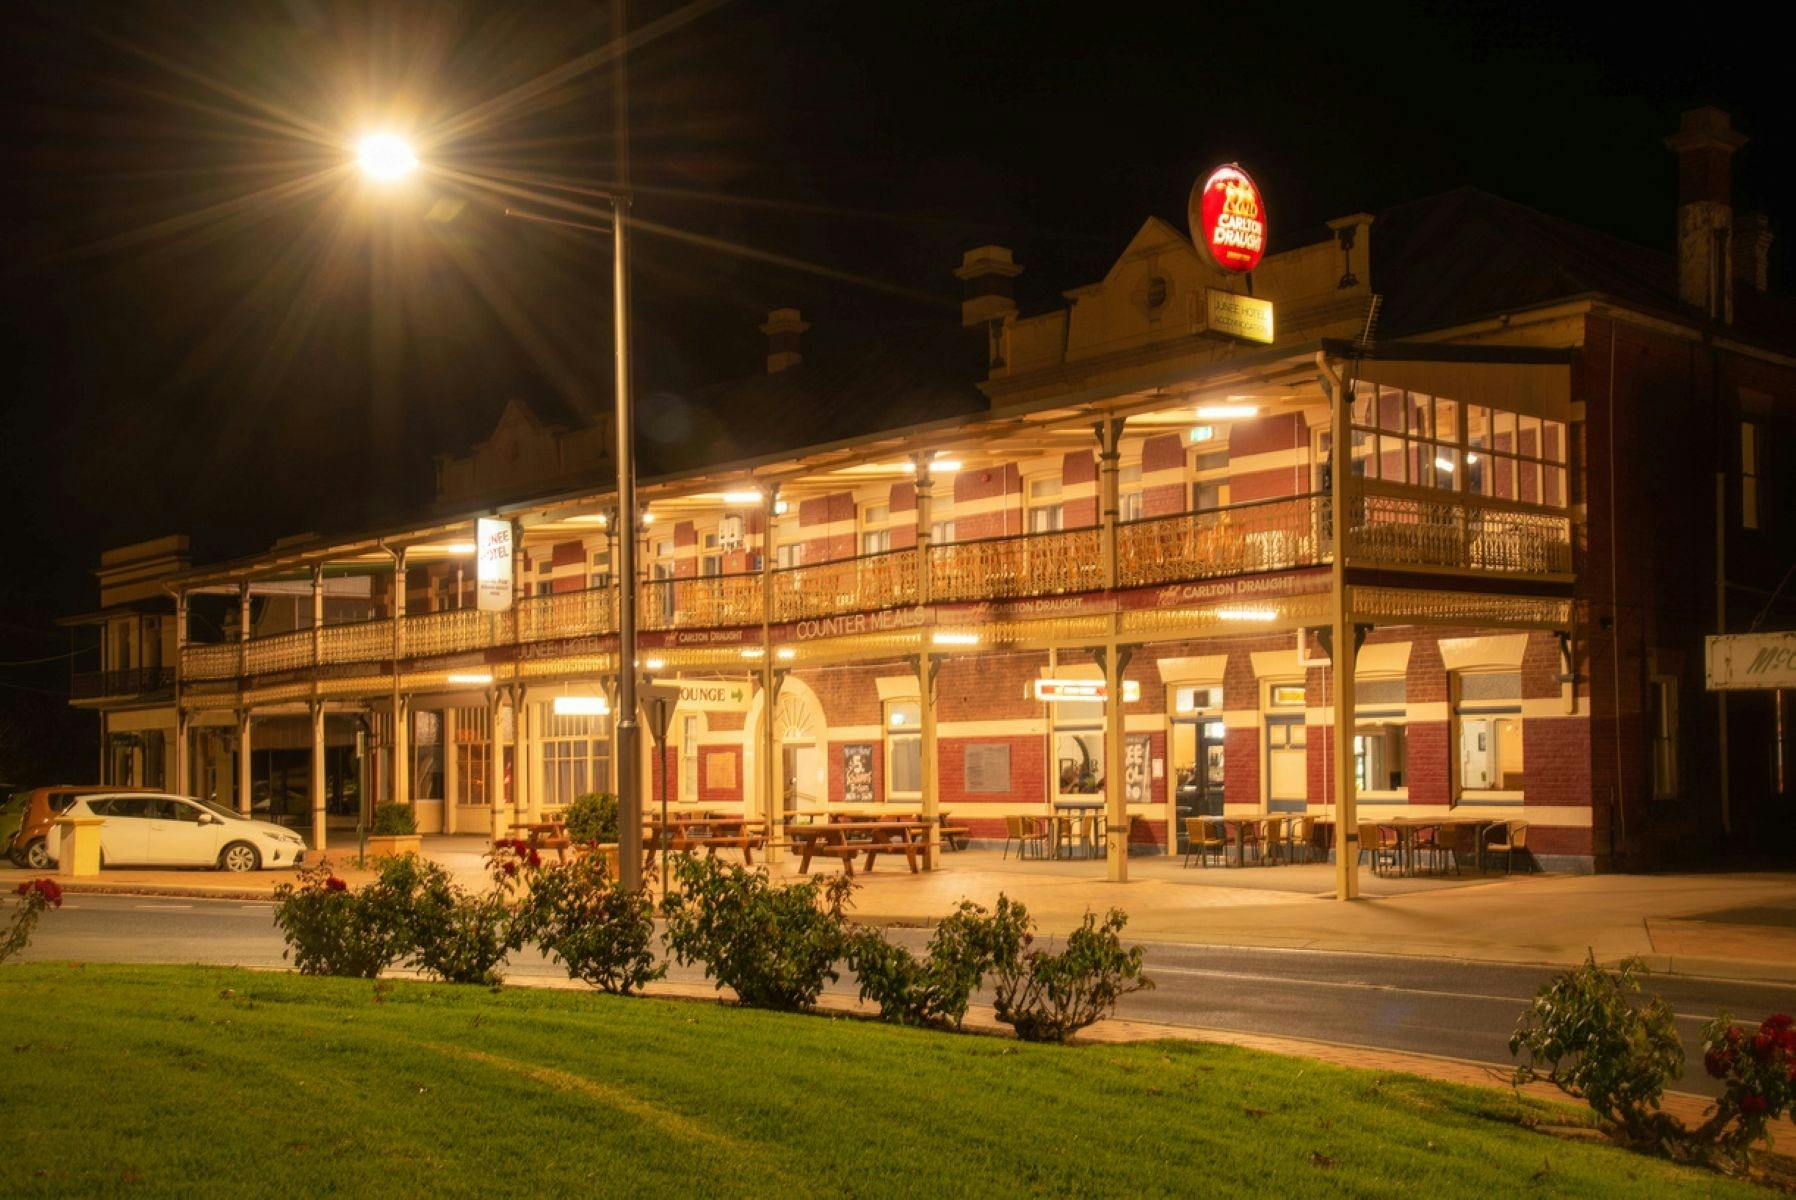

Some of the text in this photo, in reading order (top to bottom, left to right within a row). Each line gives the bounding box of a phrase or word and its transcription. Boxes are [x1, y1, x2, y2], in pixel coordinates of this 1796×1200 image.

[1218, 213, 1262, 235] CARLTON
[1213, 226, 1262, 252] DRAUGHT
[481, 545, 510, 561] OTEL
[1182, 576, 1296, 599] CARLTON DRAUGHT
[991, 597, 1084, 616] CARLTON DRAUGHT
[796, 605, 925, 640] COUNTER MEALS
[679, 630, 743, 643] CARLTON DRAUGHT
[518, 636, 605, 660] JUNEE HOTEL
[680, 686, 726, 702] OUNGE
